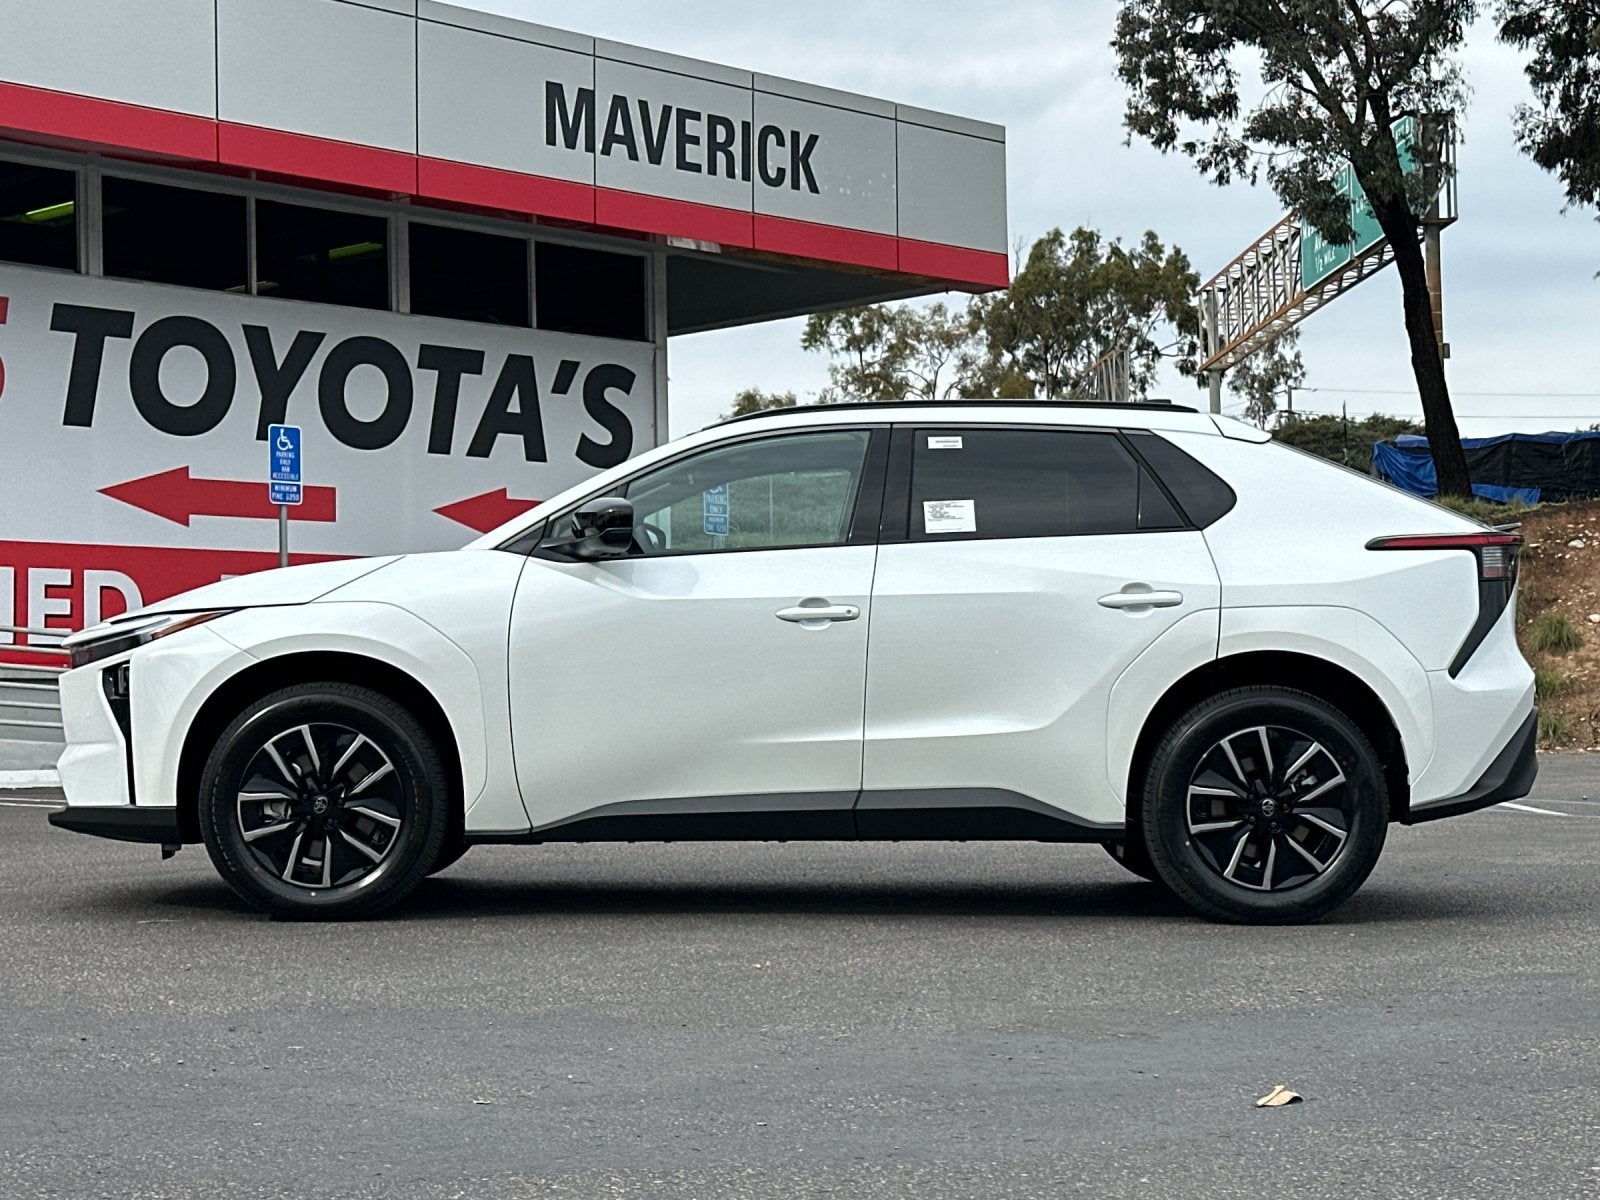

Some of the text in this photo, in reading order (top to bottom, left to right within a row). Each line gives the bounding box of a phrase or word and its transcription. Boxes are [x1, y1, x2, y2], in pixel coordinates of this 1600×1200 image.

[545, 80, 820, 195] MAVERICK
[50, 303, 636, 469] TOYOTA'S
[275, 451, 295, 459] PARKING
[281, 465, 290, 473] VAN
[272, 472, 299, 480] ACCESSIBLE
[271, 492, 284, 500] FINE
